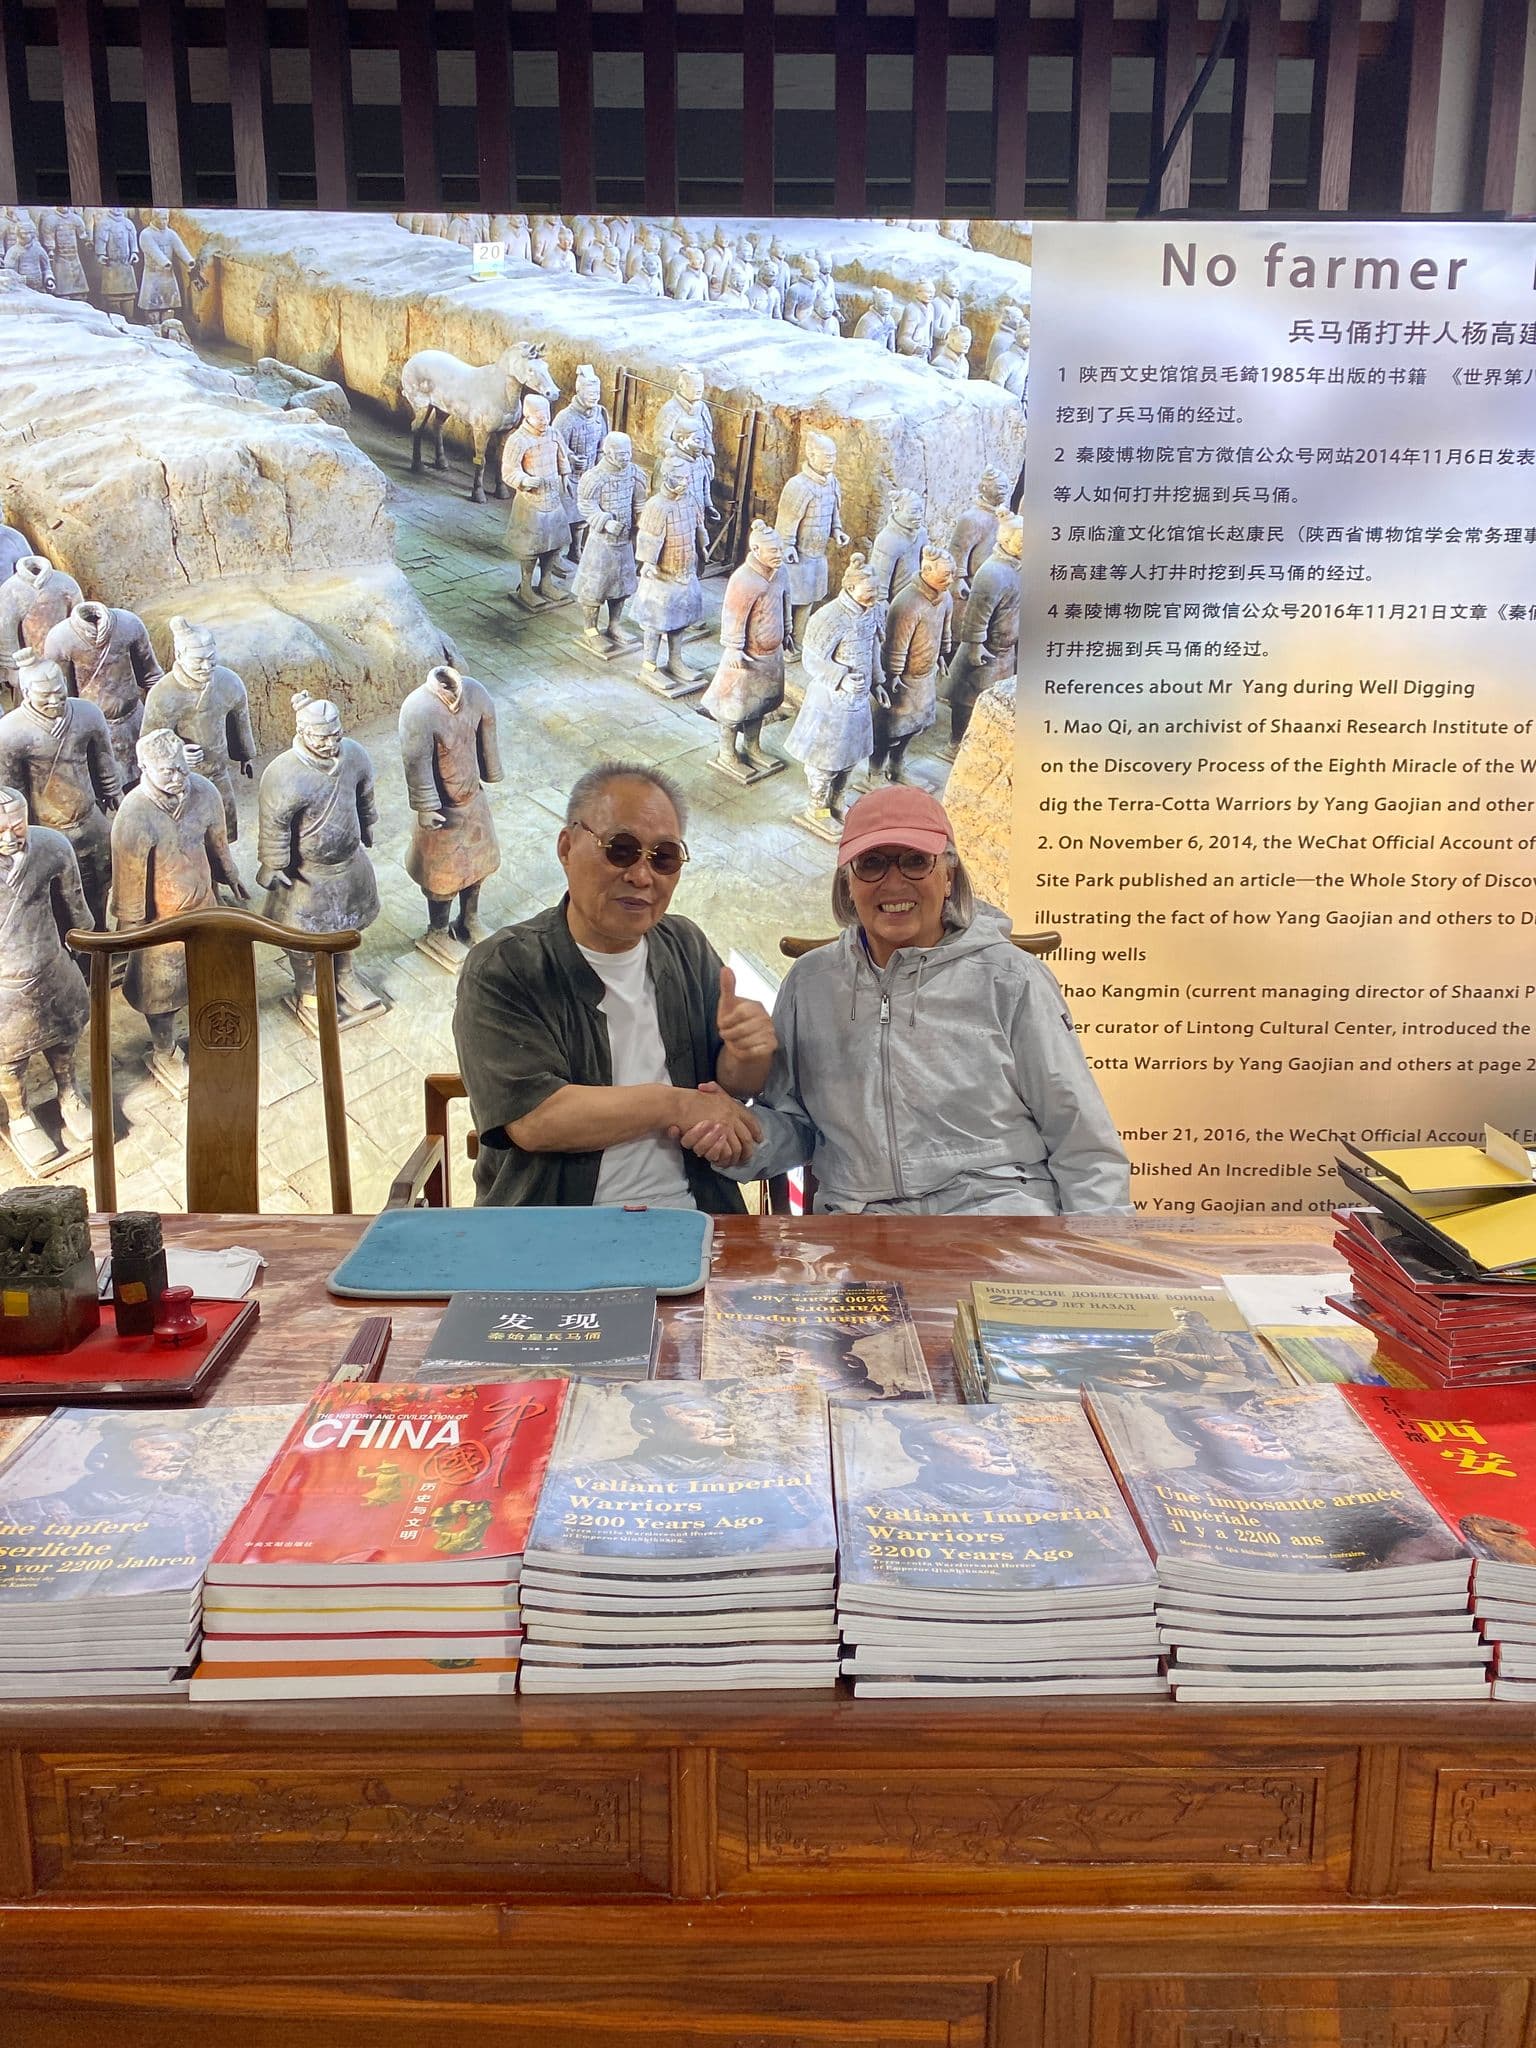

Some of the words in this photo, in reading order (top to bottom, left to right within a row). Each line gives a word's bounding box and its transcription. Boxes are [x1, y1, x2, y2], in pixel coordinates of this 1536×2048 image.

[480, 245, 500, 260] 20
[1163, 243, 1236, 287] No
[1264, 242, 1467, 290] farmer
[1288, 319, 1536, 346] 兵马俑打井人杨高建
[1059, 367, 1065, 382] 1
[1054, 448, 1064, 462] 2
[1051, 527, 1061, 541] 3
[1048, 604, 1058, 618] 4
[1045, 679, 1143, 694] References
[1149, 679, 1203, 694] about
[1208, 679, 1233, 694] Mr
[1242, 679, 1287, 697] Yang
[1293, 679, 1353, 697] during
[1359, 680, 1398, 694] Well
[1404, 680, 1475, 698] Digging
[1044, 720, 1059, 735] 1.
[1064, 720, 1103, 735] Mao
[1108, 719, 1133, 736] Qi,
[1138, 723, 1160, 734] an
[1165, 719, 1244, 734] archivist
[1248, 719, 1267, 733] of
[1271, 719, 1341, 733] Shaanxi
[1347, 719, 1427, 735] Research
[1433, 720, 1509, 735] Institute
[1514, 720, 1534, 735] of
[1041, 762, 1063, 773] on
[1069, 758, 1099, 773] the
[1105, 759, 1192, 776] Discovery
[1198, 758, 1265, 772] Process
[1271, 758, 1290, 772] of
[1293, 758, 1323, 772] the
[1329, 758, 1386, 776] Eighth
[1392, 758, 1457, 773] Miracle
[1462, 758, 1482, 773] of
[1485, 759, 1514, 773] the
[1040, 797, 1067, 815] dig
[1073, 797, 1103, 811] the
[1108, 797, 1209, 811] Terra-Cotta
[1216, 797, 1291, 811] Warriors
[1324, 797, 1368, 814] Yang
[1374, 797, 1441, 815] Gaojian
[1486, 797, 1535, 811] other
[1038, 836, 1053, 849] 2.
[1059, 836, 1083, 849] On
[1090, 835, 1183, 849] November
[1188, 835, 1203, 851] 6,
[1209, 836, 1257, 851] 2014,
[1263, 835, 1292, 849] the
[1298, 835, 1367, 849] WeChat
[1372, 835, 1434, 849] Official
[1440, 836, 1513, 849] Account
[1036, 874, 1069, 887] Site
[1075, 873, 1114, 887] Park
[1119, 873, 1207, 890] published
[1350, 873, 1406, 887] Whole
[1411, 874, 1458, 891] Story
[1035, 910, 1131, 927] illustrating
[1137, 910, 1166, 924] the
[1171, 910, 1205, 924] fact
[1233, 910, 1271, 924] how
[1276, 911, 1320, 927] Yang
[1326, 911, 1392, 928] Gaojian
[1437, 911, 1492, 924] others
[1102, 947, 1146, 961] wells
[1102, 984, 1179, 1001] Kangmin
[1186, 984, 1256, 999] (current
[1262, 985, 1350, 1001] managing
[1355, 985, 1425, 998] director
[1451, 985, 1519, 998] Shaanxi
[1095, 1022, 1159, 1034] curator
[1187, 1021, 1254, 1037] Lintong
[1260, 1021, 1329, 1034] Cultural
[1335, 1022, 1396, 1036] Center,
[1402, 1021, 1497, 1035] introduced
[1502, 1021, 1530, 1035] the
[1134, 1057, 1207, 1070] Warriors
[1239, 1057, 1282, 1073] Yang
[1288, 1057, 1353, 1074] Gaojian
[1397, 1057, 1452, 1071] others
[1479, 1061, 1521, 1074] page
[1173, 1128, 1198, 1143] 21,
[1203, 1129, 1250, 1143] 2016,
[1256, 1128, 1284, 1142] the
[1289, 1129, 1356, 1142] WeChat
[1361, 1129, 1423, 1142] Official
[1197, 1164, 1220, 1176] An
[1227, 1164, 1312, 1176] Incredible
[1152, 1198, 1195, 1214] Yang
[1201, 1199, 1265, 1216] Gaojian
[988, 1294, 1058, 1308] 2200
[302, 1419, 462, 1450] CHINA
[574, 1476, 678, 1493] Valiant
[687, 1472, 812, 1494] Imperial
[569, 1495, 702, 1512] Warriors
[1154, 1485, 1201, 1505] Une
[1207, 1493, 1328, 1513] imposante
[1331, 1487, 1405, 1508] armée
[563, 1514, 625, 1528] 2200
[634, 1517, 706, 1530] Years
[714, 1516, 764, 1530] Ago
[865, 1506, 974, 1524] Valiant
[982, 1506, 1112, 1526] Imperial
[1163, 1503, 1261, 1527] impériale
[43, 1520, 150, 1538] tapfere
[866, 1525, 1006, 1543] Warriors
[1234, 1529, 1281, 1546] 2200
[1290, 1534, 1325, 1547] ans
[868, 1545, 931, 1559] 2200
[939, 1548, 1014, 1561] Years
[1023, 1548, 1075, 1562] Ago
[15, 1564, 53, 1574] vor
[56, 1558, 114, 1573] 2200
[116, 1554, 197, 1569] Jahren
